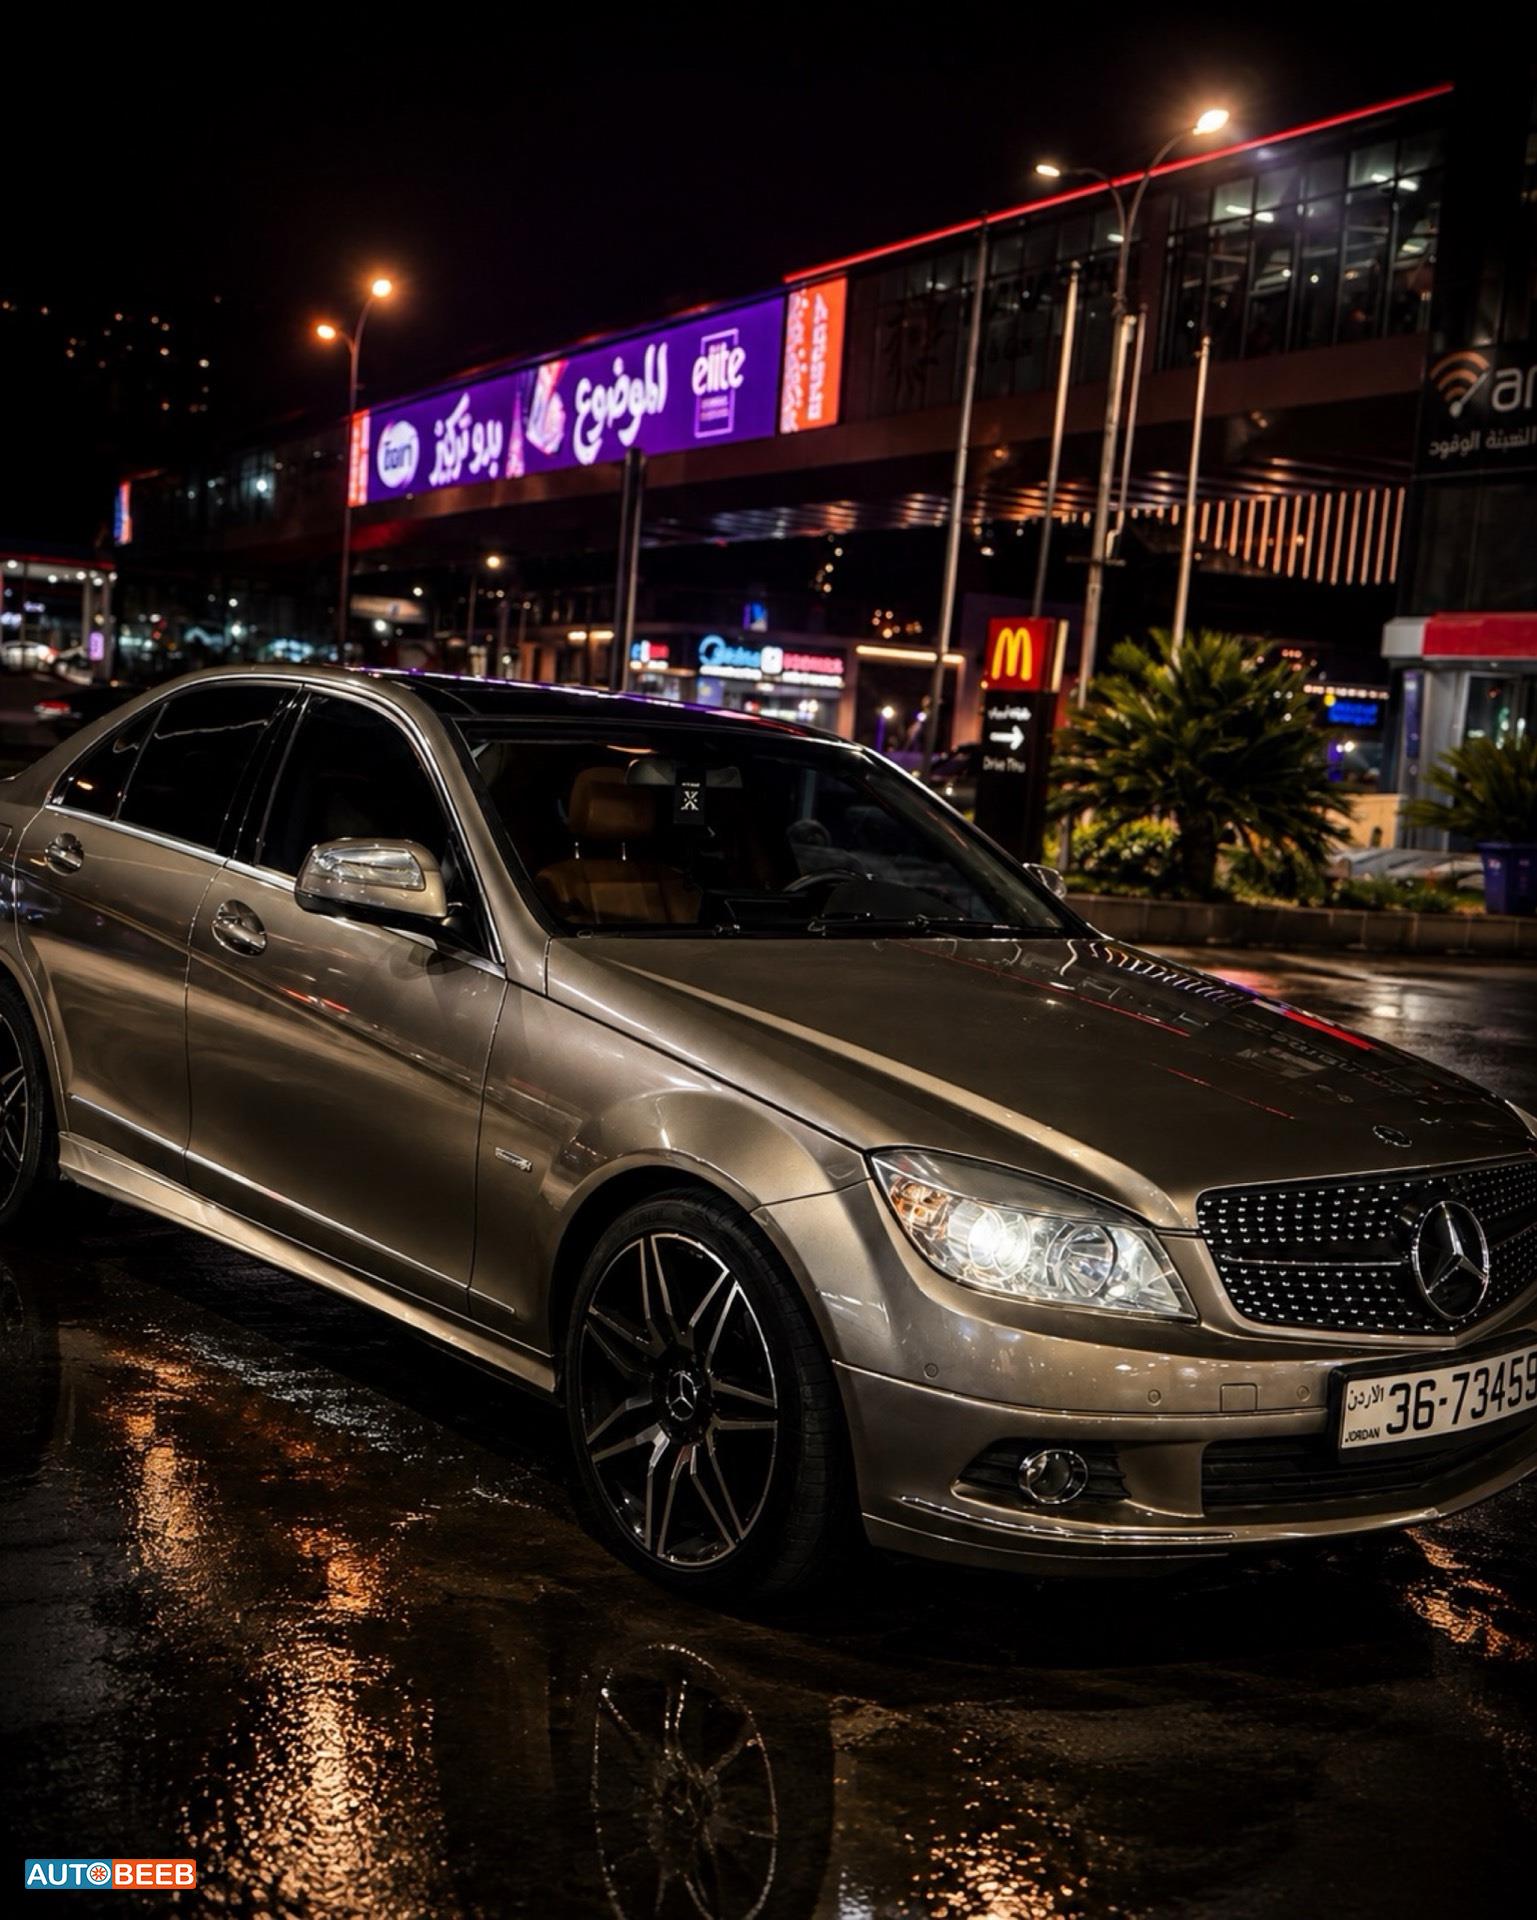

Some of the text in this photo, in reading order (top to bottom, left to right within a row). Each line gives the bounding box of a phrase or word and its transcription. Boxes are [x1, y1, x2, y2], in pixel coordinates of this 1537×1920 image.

[573, 342, 668, 465] الموضوع
[1344, 1427, 1380, 1443] JORDAN
[1386, 1351, 1537, 1435] 36-73459
